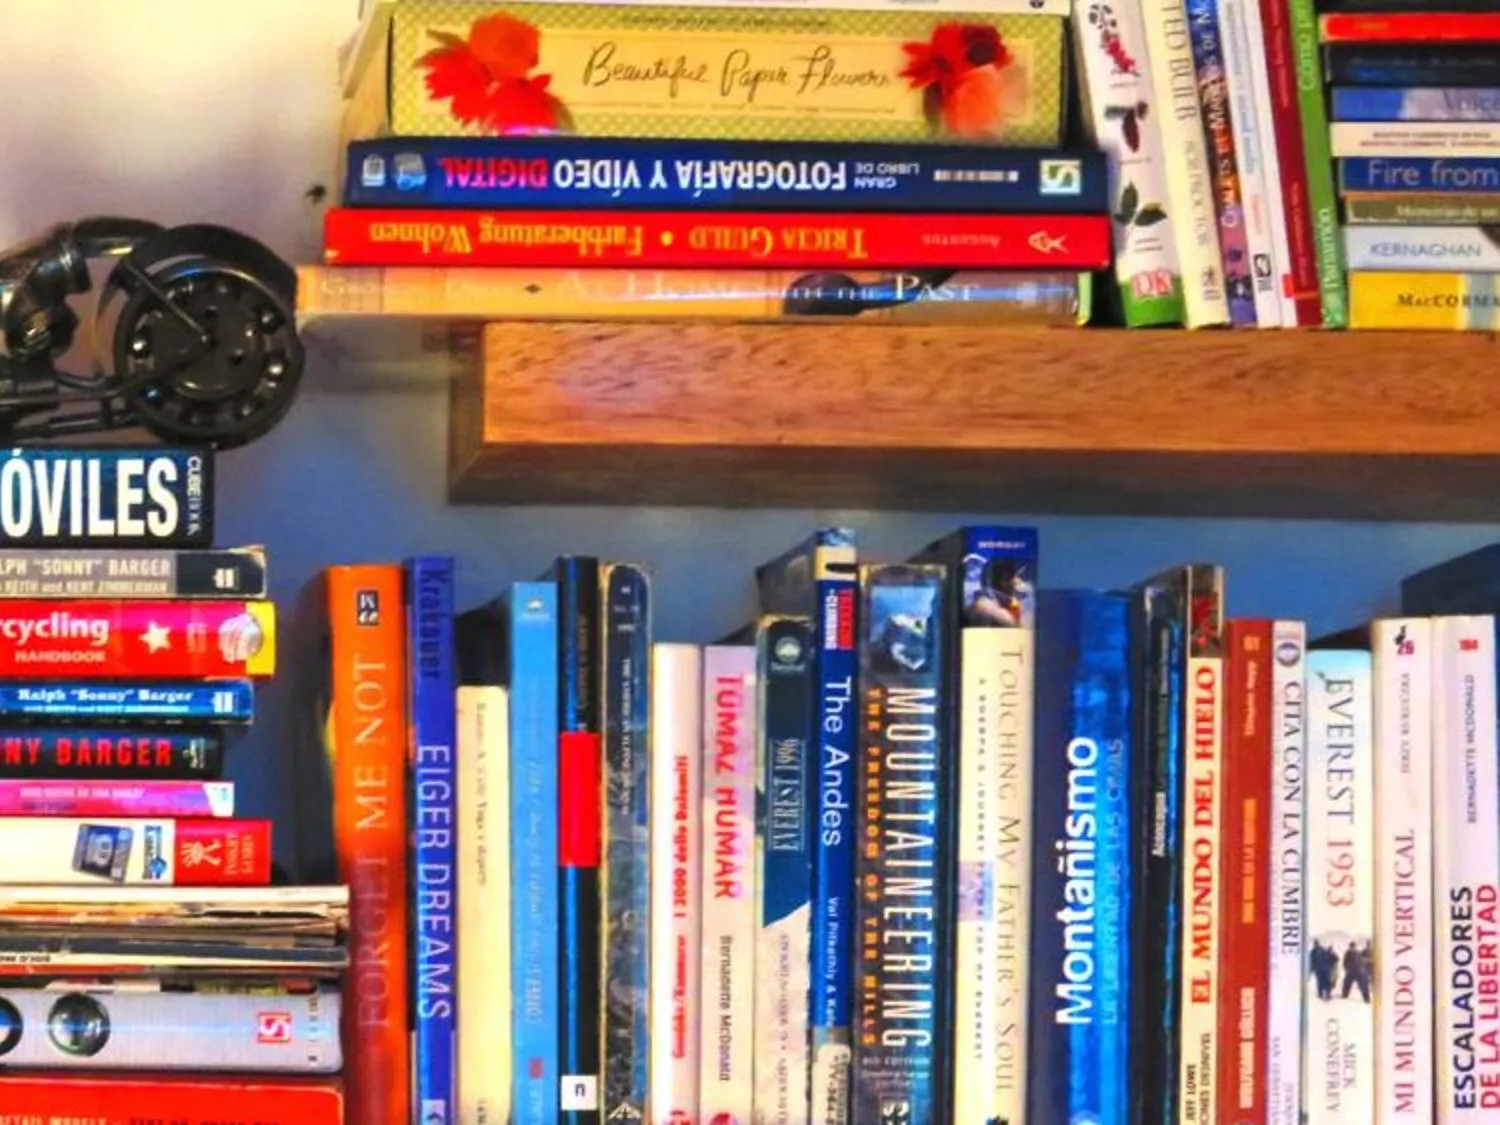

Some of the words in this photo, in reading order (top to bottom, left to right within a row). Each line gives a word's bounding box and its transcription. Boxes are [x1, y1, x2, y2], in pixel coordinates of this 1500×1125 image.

[440, 158, 549, 189] DIGITAL
[553, 159, 642, 195] VÍDEO
[648, 159, 668, 190] Y
[674, 159, 847, 196] FOTOGRAFÍA
[1368, 160, 1420, 185] Fire
[1431, 160, 1499, 187] from
[369, 222, 472, 254] Wohnen
[479, 223, 643, 256] Farbberatung
[688, 226, 775, 254] GUILD
[783, 227, 868, 258] TRICIA
[1369, 242, 1482, 258] KERNAGHAN
[109, 557, 171, 576] BARGER
[352, 652, 388, 746] NOT
[824, 676, 853, 734] The
[1195, 664, 1217, 761] HIELO
[55, 738, 173, 766] BARGER
[1322, 678, 1356, 826] EVEREST
[353, 765, 390, 831] ME
[416, 744, 451, 850] EIGER
[822, 743, 850, 847] Andes
[865, 747, 881, 861] FREEDOM
[1194, 771, 1215, 829] DEL
[882, 686, 938, 1048] MOUNTAINEERING
[1055, 735, 1100, 1026] Montañismo
[1395, 829, 1416, 957] VERTICAL
[1192, 838, 1214, 962] MUNDO
[416, 862, 452, 1020] DREAMS
[1476, 884, 1498, 1021] LIBERTAD
[863, 975, 879, 1046] HILLS
[1192, 969, 1212, 1005] EL
[1451, 886, 1477, 1110] ESCALADORES
[1394, 965, 1416, 1072] MUNDO
[1478, 1030, 1499, 1064] LA
[1394, 1082, 1415, 1114] MI
[1479, 1072, 1500, 1110] DE
